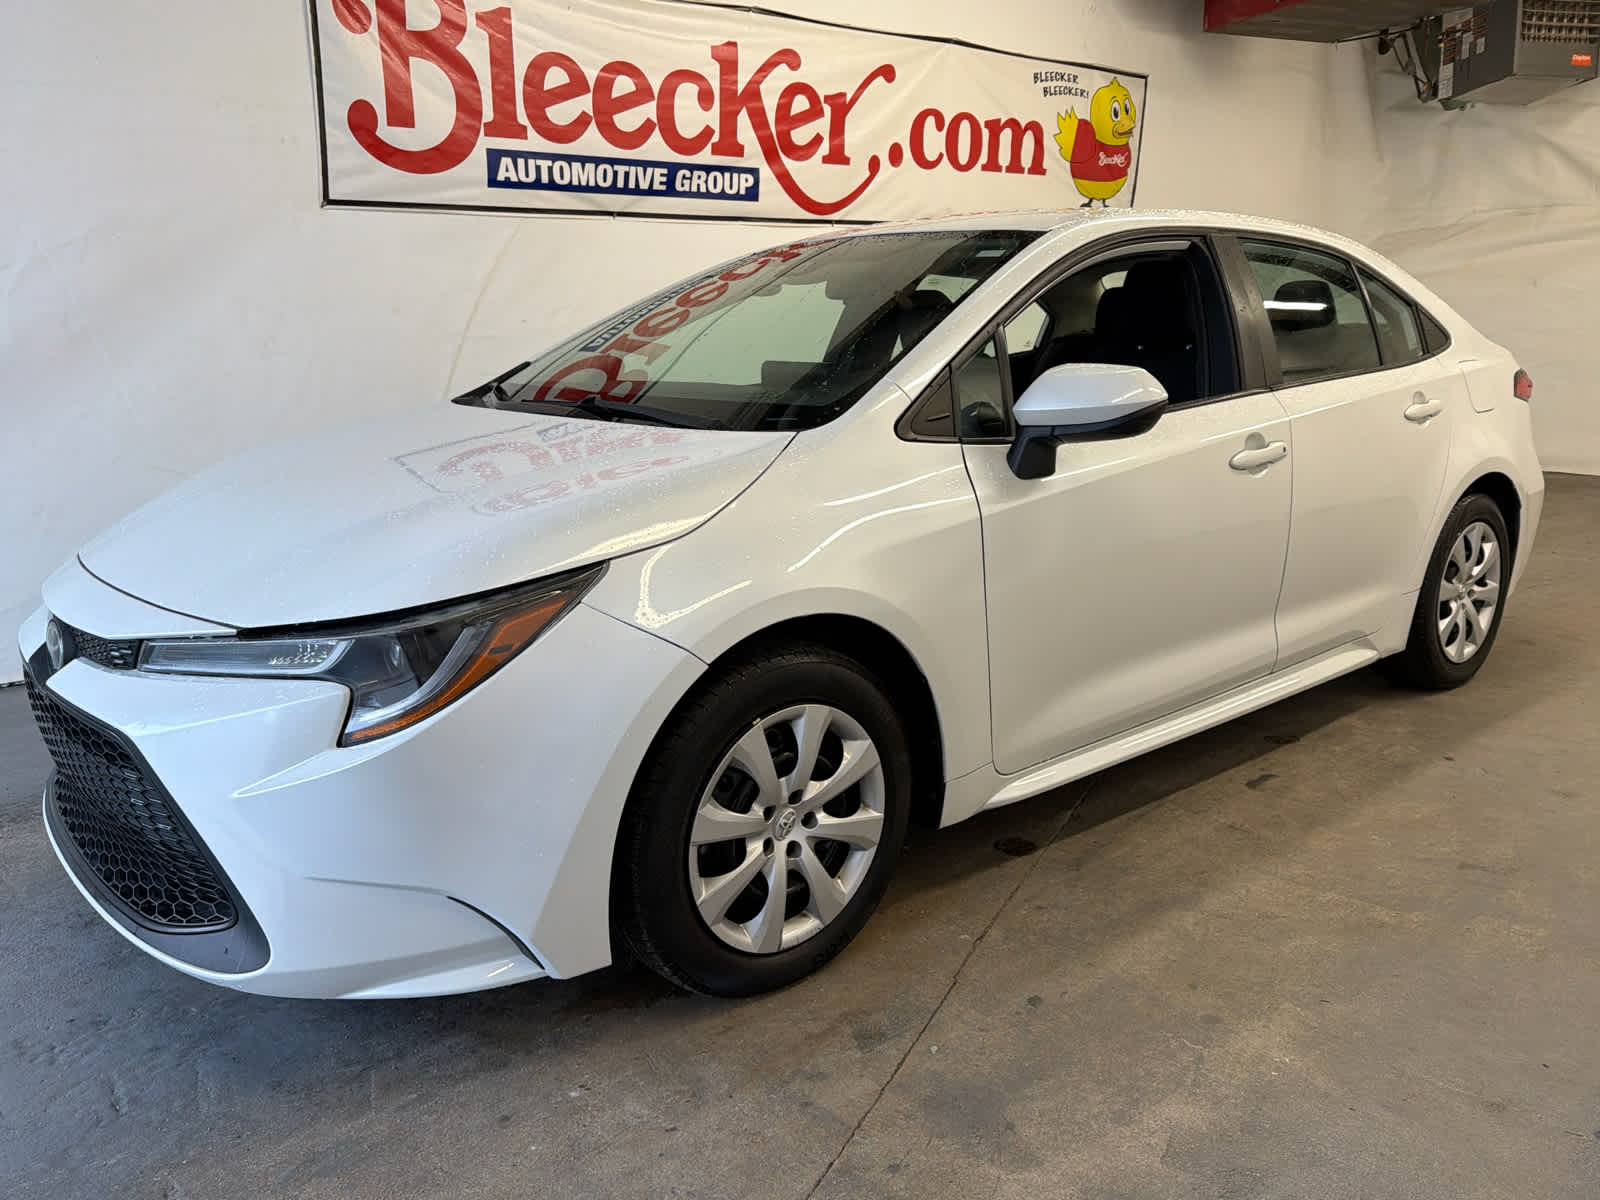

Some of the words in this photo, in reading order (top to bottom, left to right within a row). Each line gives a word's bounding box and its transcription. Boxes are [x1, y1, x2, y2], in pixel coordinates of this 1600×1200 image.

[1033, 71, 1080, 85] BLEECKER
[1043, 85, 1090, 99] BLEECKER!
[496, 156, 668, 191] AUTOMOTIVE
[675, 169, 755, 195] GROUP
